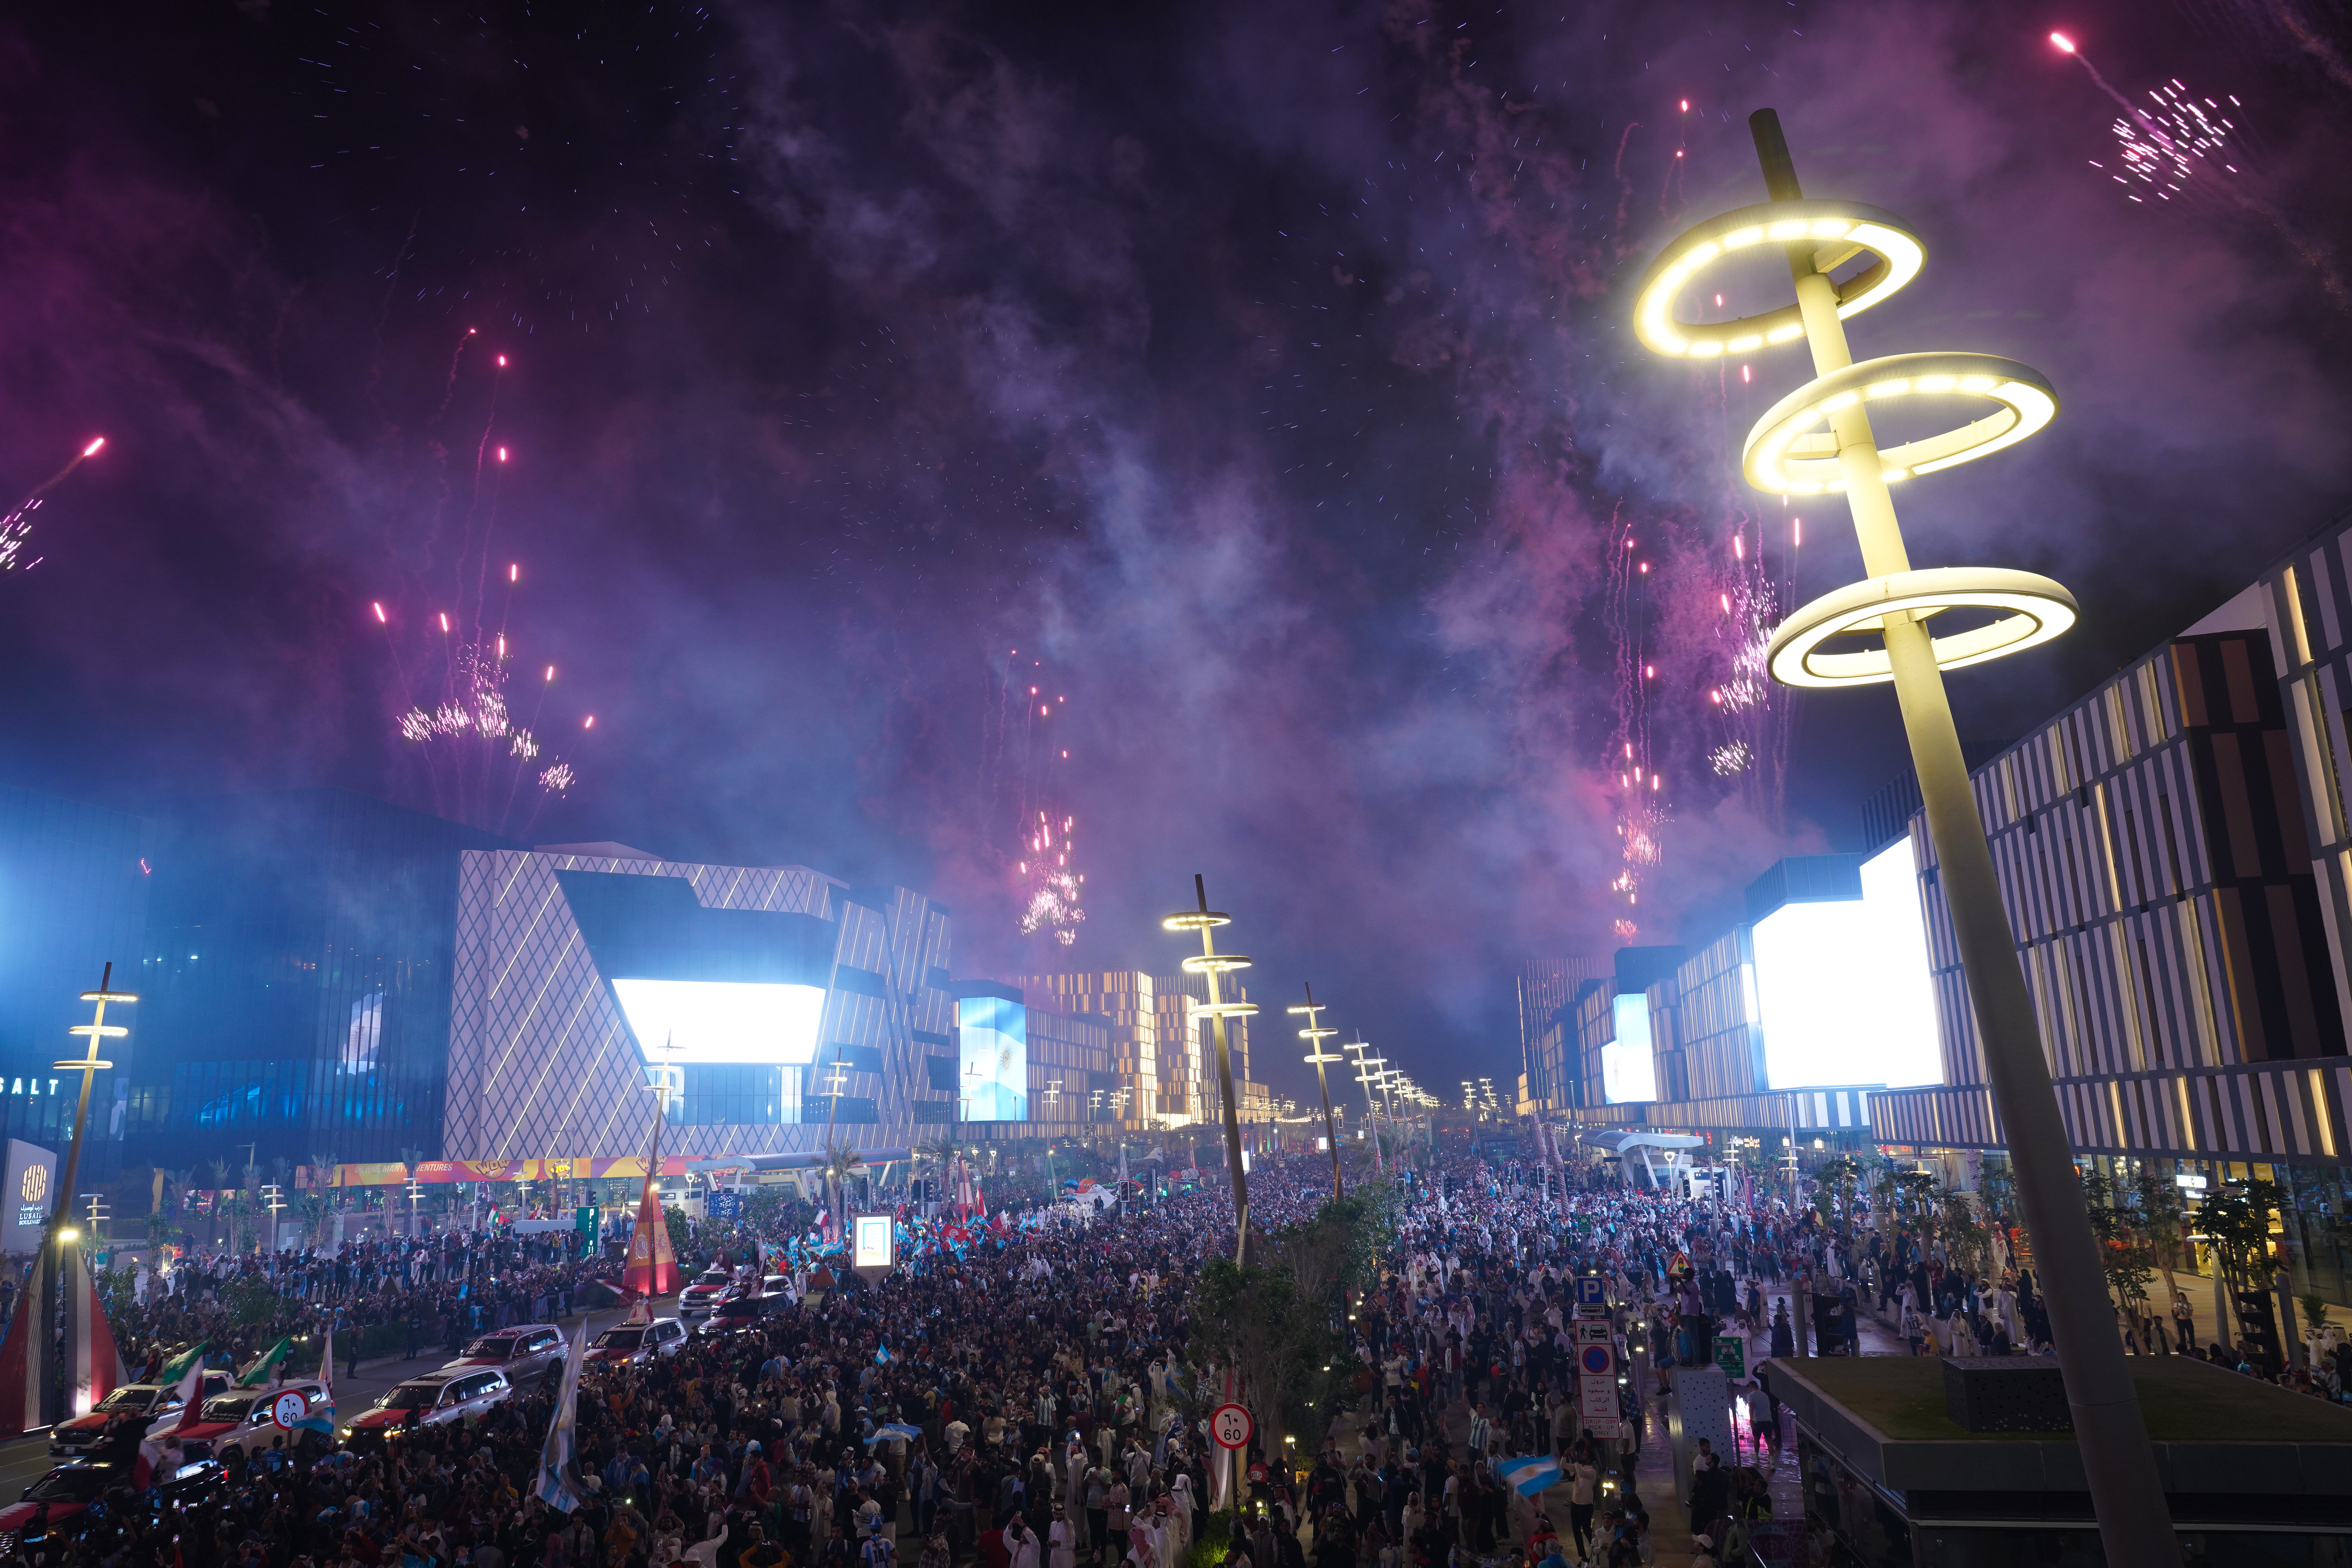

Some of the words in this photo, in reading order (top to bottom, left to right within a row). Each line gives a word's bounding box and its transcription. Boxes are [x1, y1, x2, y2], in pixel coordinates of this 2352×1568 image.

[382, 1164, 406, 1172] MANY
[405, 1163, 453, 1172] VENTURES
[477, 1160, 511, 1175] WOW
[636, 1156, 668, 1171] WW
[1583, 1280, 1600, 1302] P
[283, 1412, 297, 1423] 60
[1224, 1428, 1241, 1440] 60
